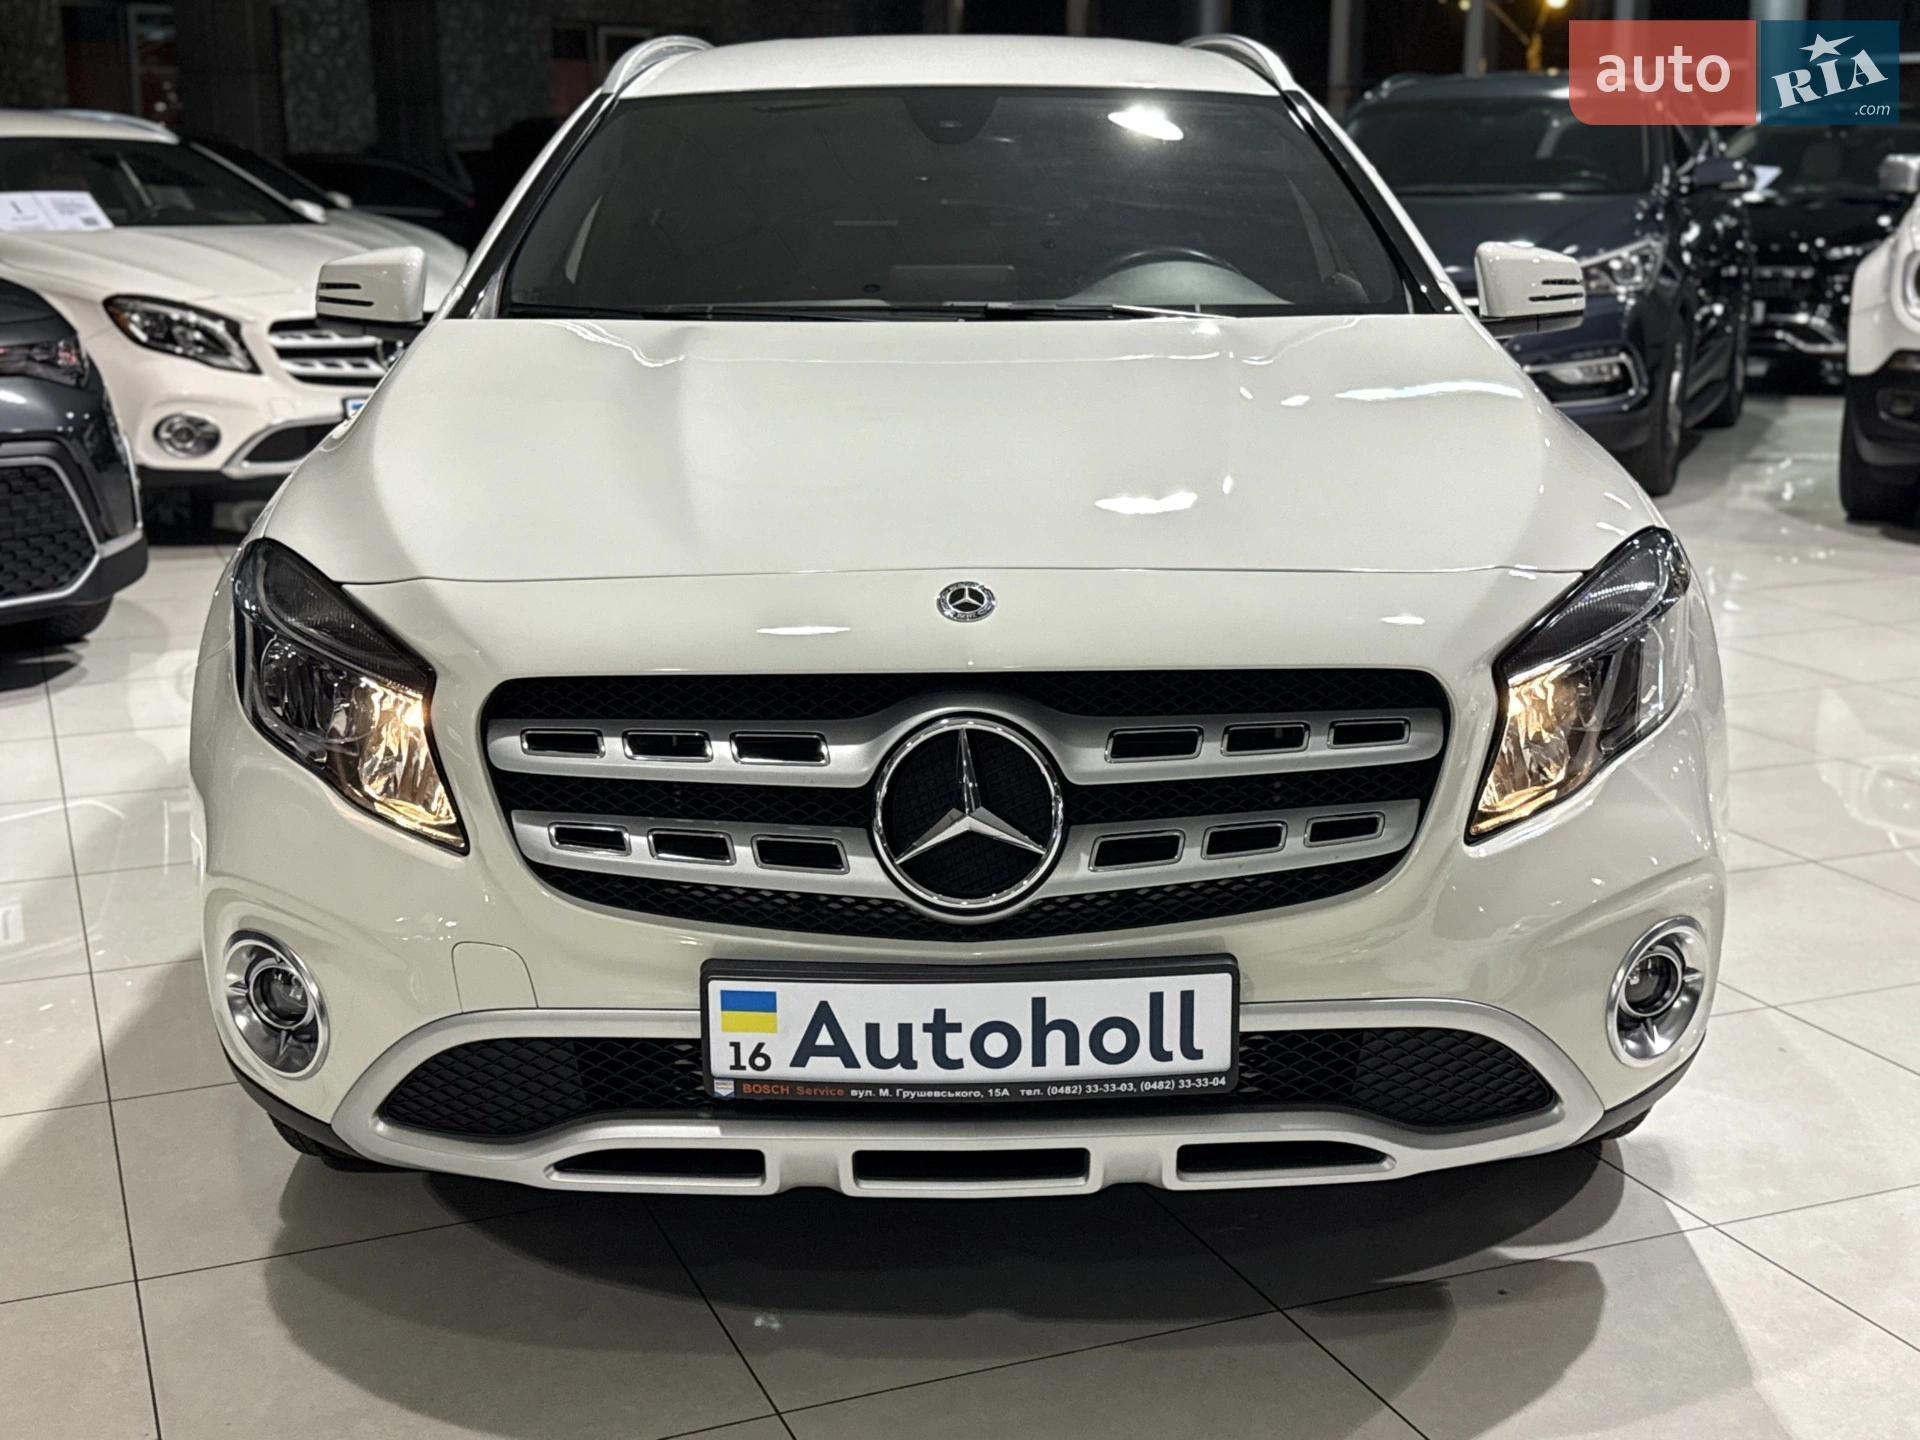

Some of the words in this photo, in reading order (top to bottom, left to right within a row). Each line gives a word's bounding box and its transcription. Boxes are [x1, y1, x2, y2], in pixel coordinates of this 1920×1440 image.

[728, 1040, 772, 1072] 16
[789, 989, 1204, 1071] Autoholl
[743, 1083, 790, 1095] BOSCH
[796, 1086, 845, 1097] Service
[850, 1089, 876, 1099] вул.
[879, 1088, 893, 1097] М.
[896, 1088, 984, 1099] Грушевського,
[988, 1088, 1010, 1097] 15А
[1019, 1088, 1044, 1096] тел.
[1047, 1085, 1082, 1096] (0482)
[1085, 1083, 1137, 1094] 33-33-03,
[1140, 1080, 1175, 1092] (0482)
[1178, 1077, 1226, 1088] 33-33-04
